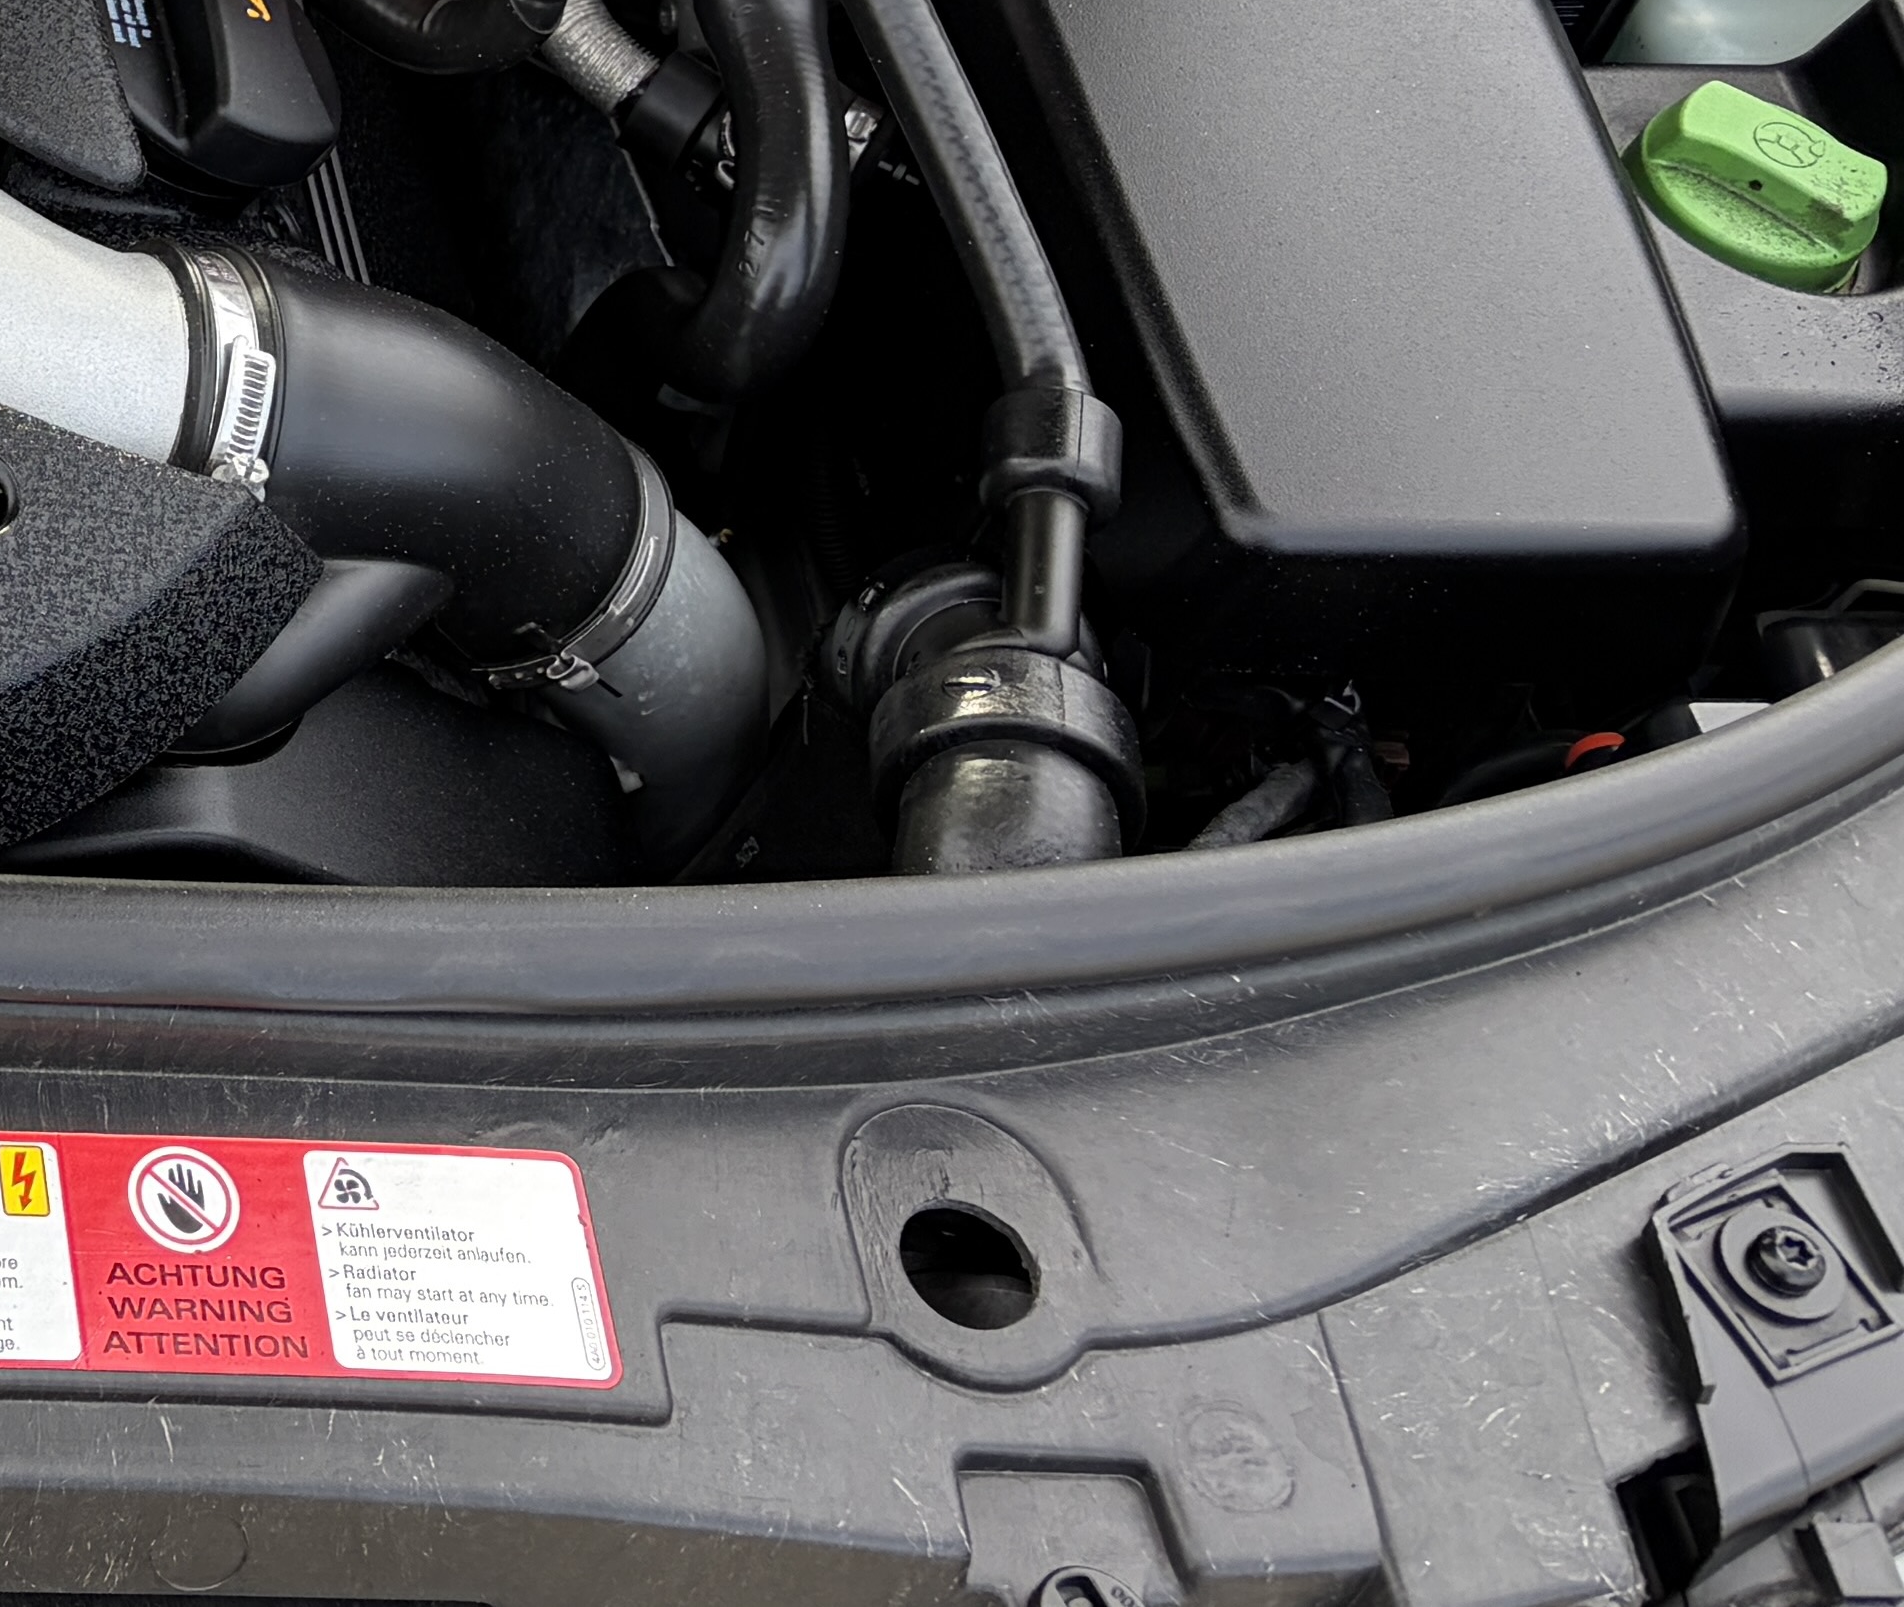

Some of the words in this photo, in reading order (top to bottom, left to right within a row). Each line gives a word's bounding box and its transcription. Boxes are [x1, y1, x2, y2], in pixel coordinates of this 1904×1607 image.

[336, 1223, 474, 1242] Kühlerventilator
[339, 1242, 378, 1256] kann
[384, 1244, 452, 1260] jederzeit
[458, 1247, 530, 1263] anlaufen.
[106, 1263, 286, 1289] ACHTUNG
[343, 1264, 416, 1281] Radiator
[346, 1284, 371, 1298] fan
[377, 1288, 411, 1302] may
[418, 1288, 454, 1301] start
[459, 1290, 474, 1302] at
[480, 1292, 506, 1307] any
[513, 1292, 553, 1306] time.
[108, 1297, 292, 1323] WARNING
[350, 1308, 370, 1321] Le
[376, 1309, 468, 1325] ventilateur
[103, 1330, 308, 1358] ATTENTION
[353, 1329, 391, 1343] peut
[397, 1331, 415, 1342] se
[421, 1329, 509, 1346] déclencher
[357, 1347, 365, 1359] à
[371, 1348, 403, 1361] tout
[410, 1350, 484, 1364] moment.
